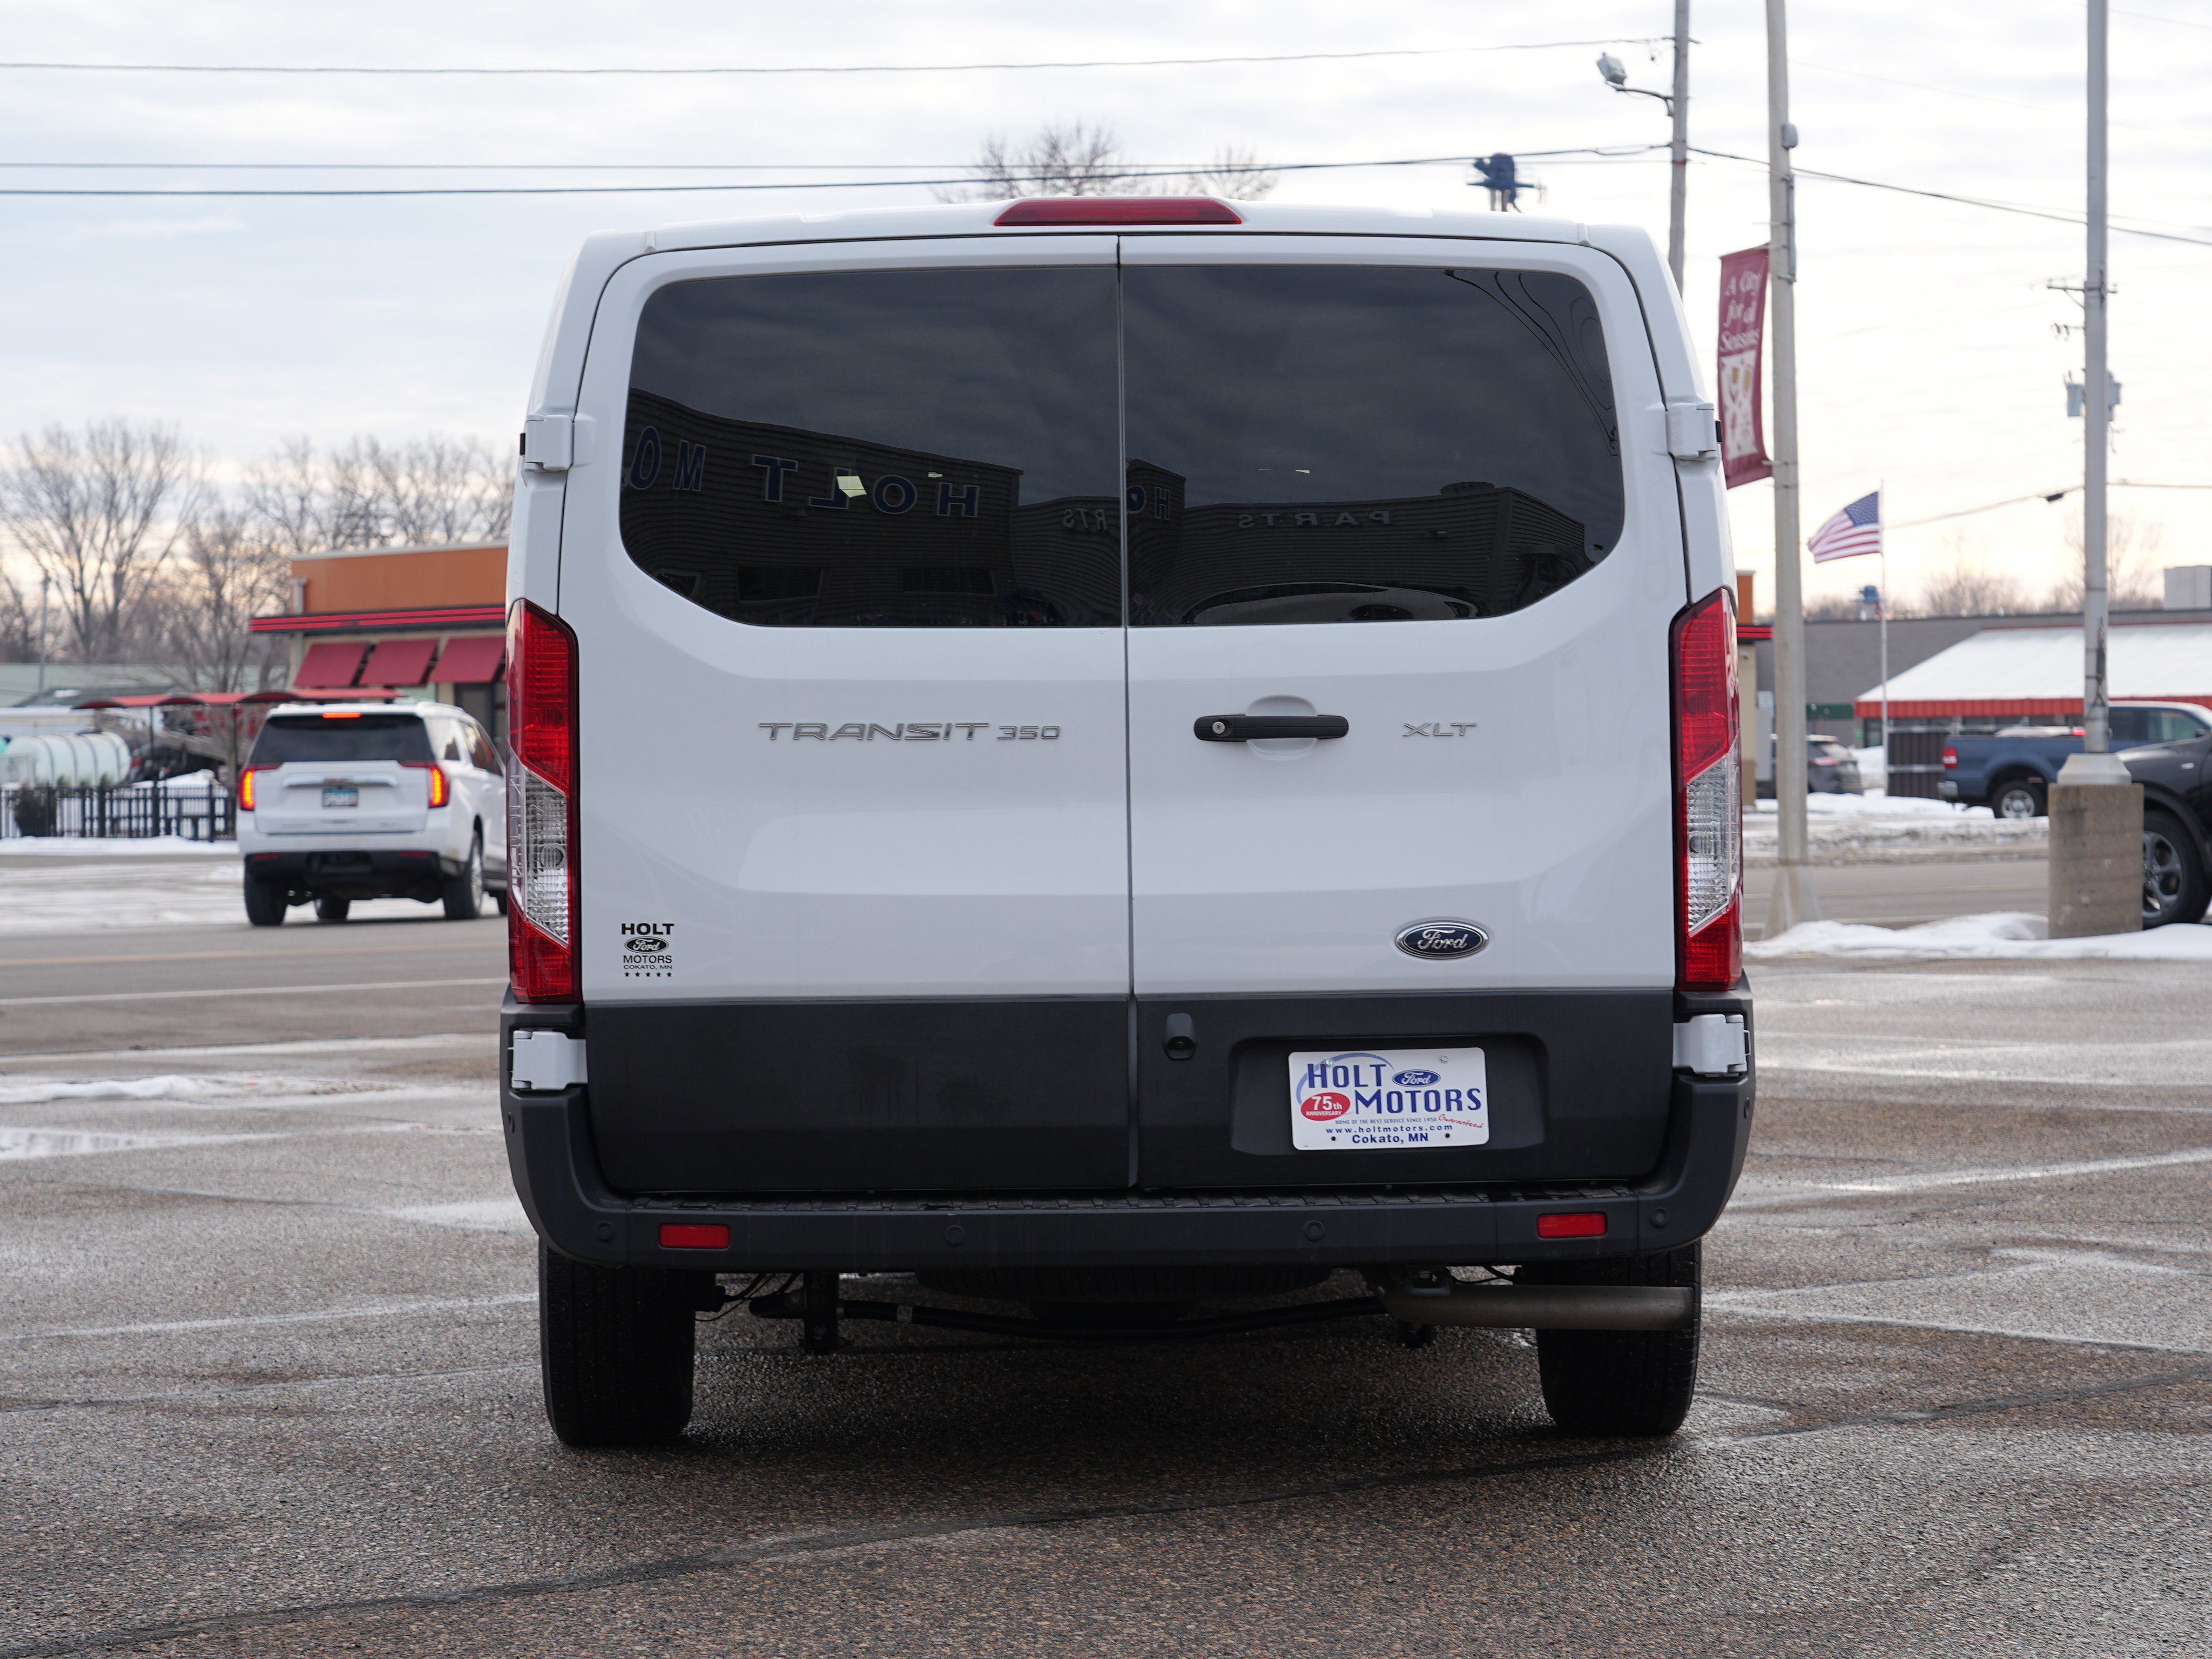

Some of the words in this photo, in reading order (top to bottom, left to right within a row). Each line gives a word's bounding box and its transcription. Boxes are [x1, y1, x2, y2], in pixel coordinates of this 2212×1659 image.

[759, 723, 989, 740] TRANSIT
[997, 725, 1061, 740] 350
[1402, 723, 1477, 737] XLT
[621, 923, 675, 935] HOLT
[632, 939, 660, 950] Ford
[1417, 929, 1468, 949] Ford
[623, 955, 672, 963] MOTORS
[1307, 1063, 1386, 1088] HOLT
[1401, 1072, 1431, 1085] Ford
[1311, 1096, 1343, 1111] 75th
[1354, 1088, 1481, 1115] MOTORS
[1438, 1114, 1484, 1129] Guaranteed
[1326, 1124, 1453, 1134] www.holtmotors.com
[1352, 1134, 1404, 1144] Cokato,
[1408, 1133, 1428, 1142] MN
